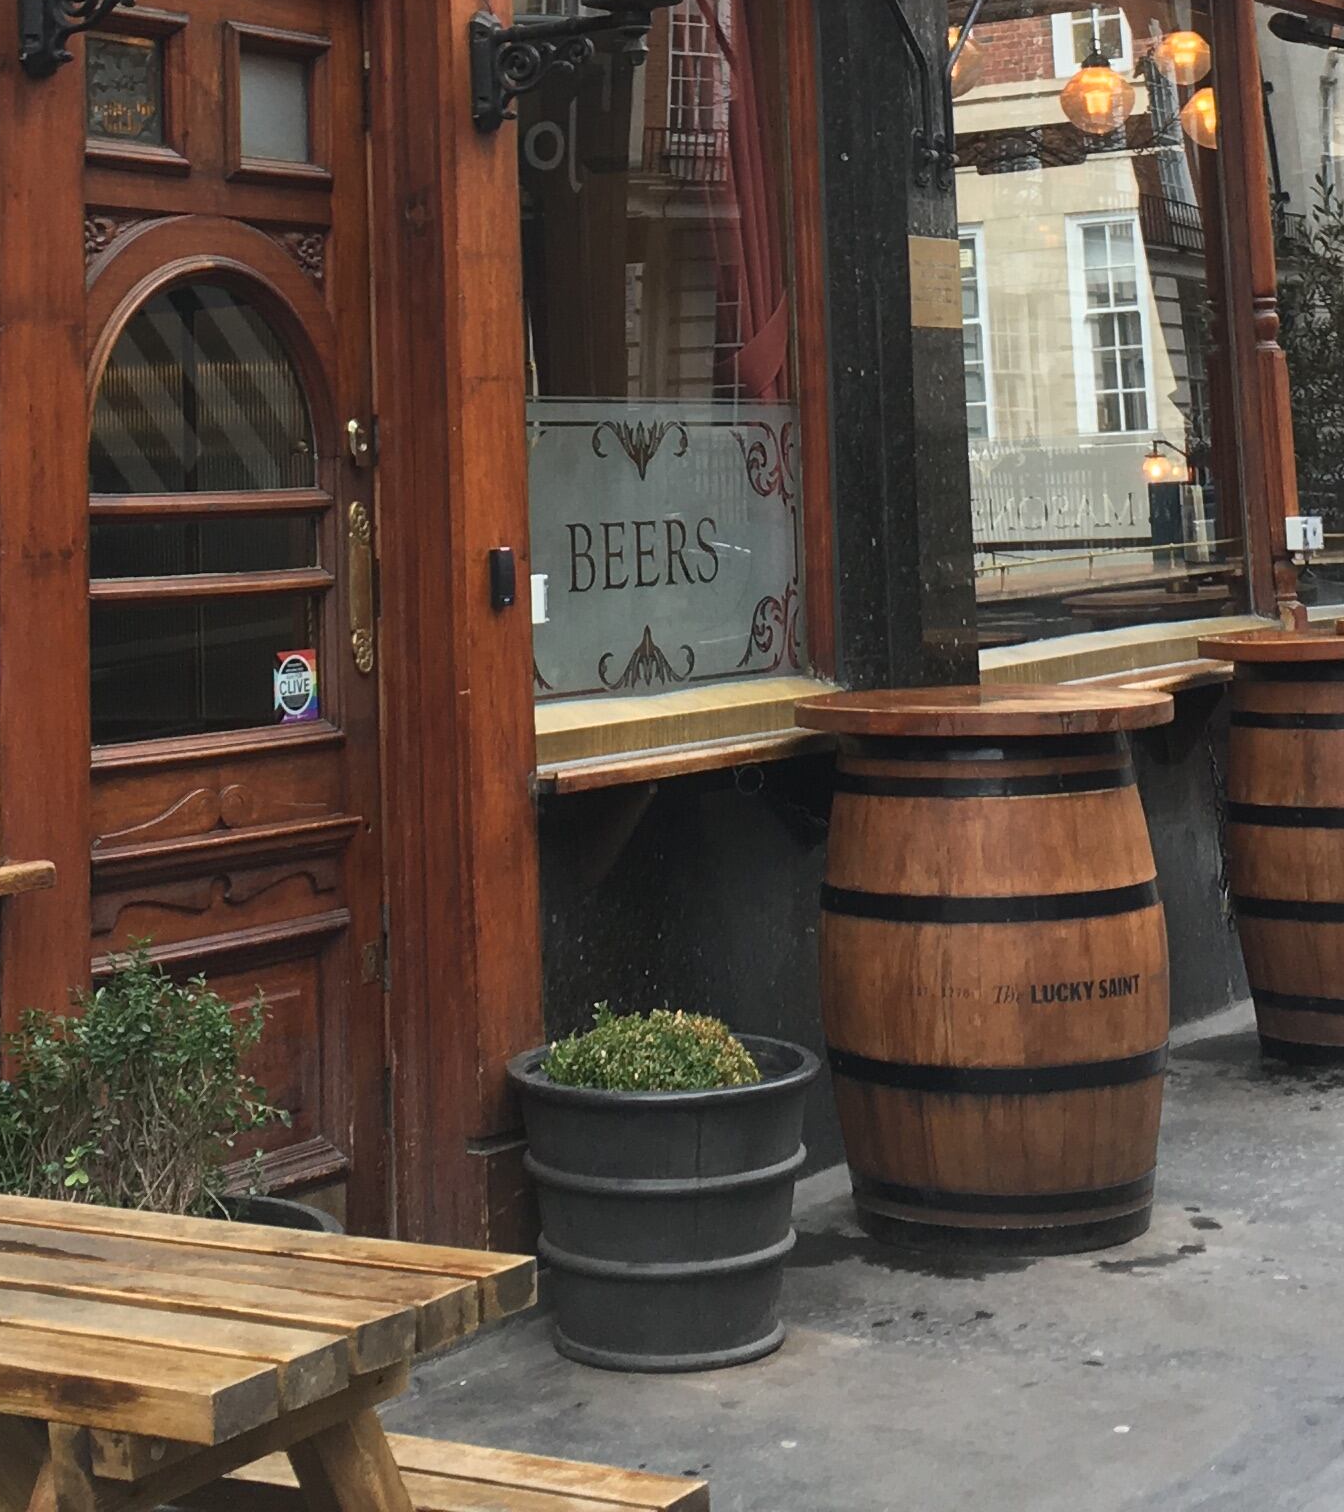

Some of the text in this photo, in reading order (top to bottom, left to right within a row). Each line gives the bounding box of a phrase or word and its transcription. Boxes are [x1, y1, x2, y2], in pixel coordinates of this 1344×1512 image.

[565, 517, 720, 593] BEERS
[279, 678, 311, 695] CLIVE
[1031, 980, 1094, 1004] LUCKY
[1098, 973, 1141, 1001] SAINT
